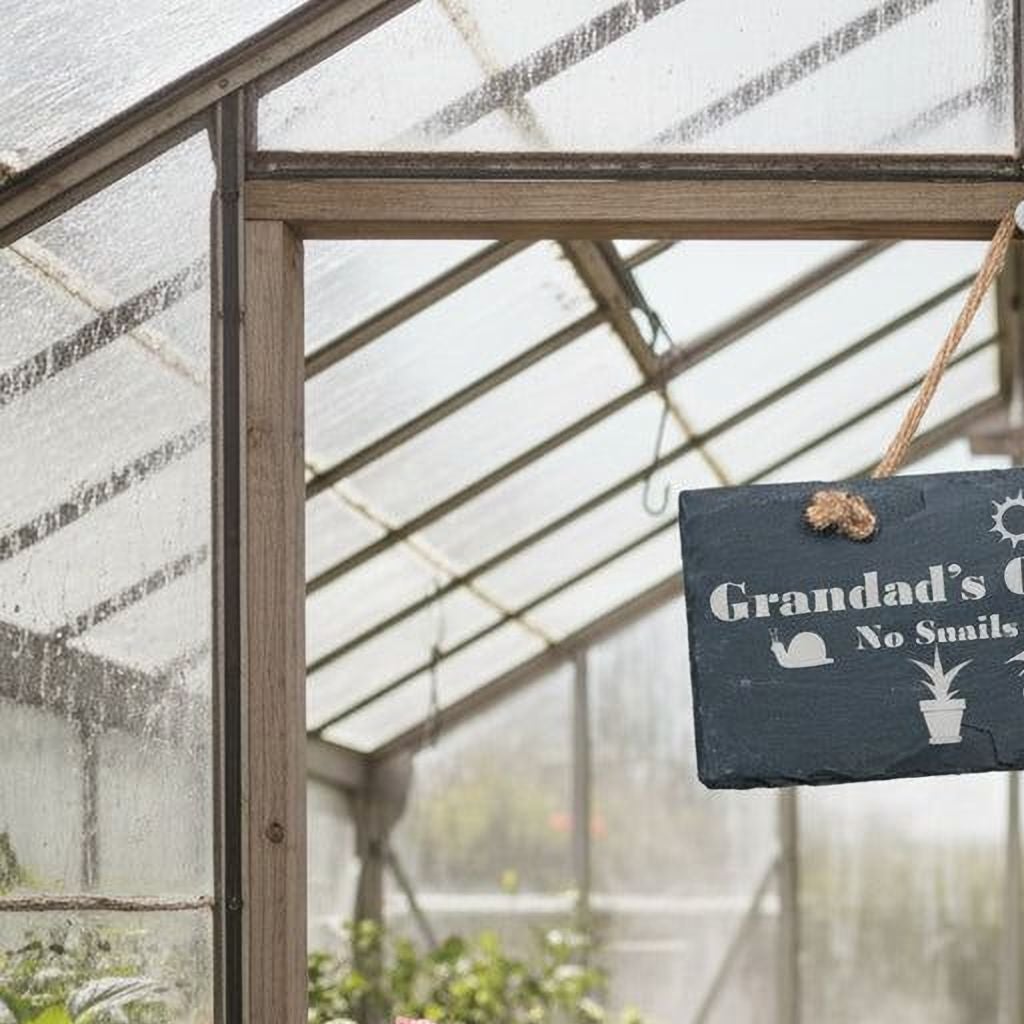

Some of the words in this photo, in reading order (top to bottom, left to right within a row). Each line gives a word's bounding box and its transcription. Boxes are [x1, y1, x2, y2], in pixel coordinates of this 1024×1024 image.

[709, 563, 987, 622] Grandad's
[855, 624, 904, 650] No
[915, 613, 1019, 645] Snails
